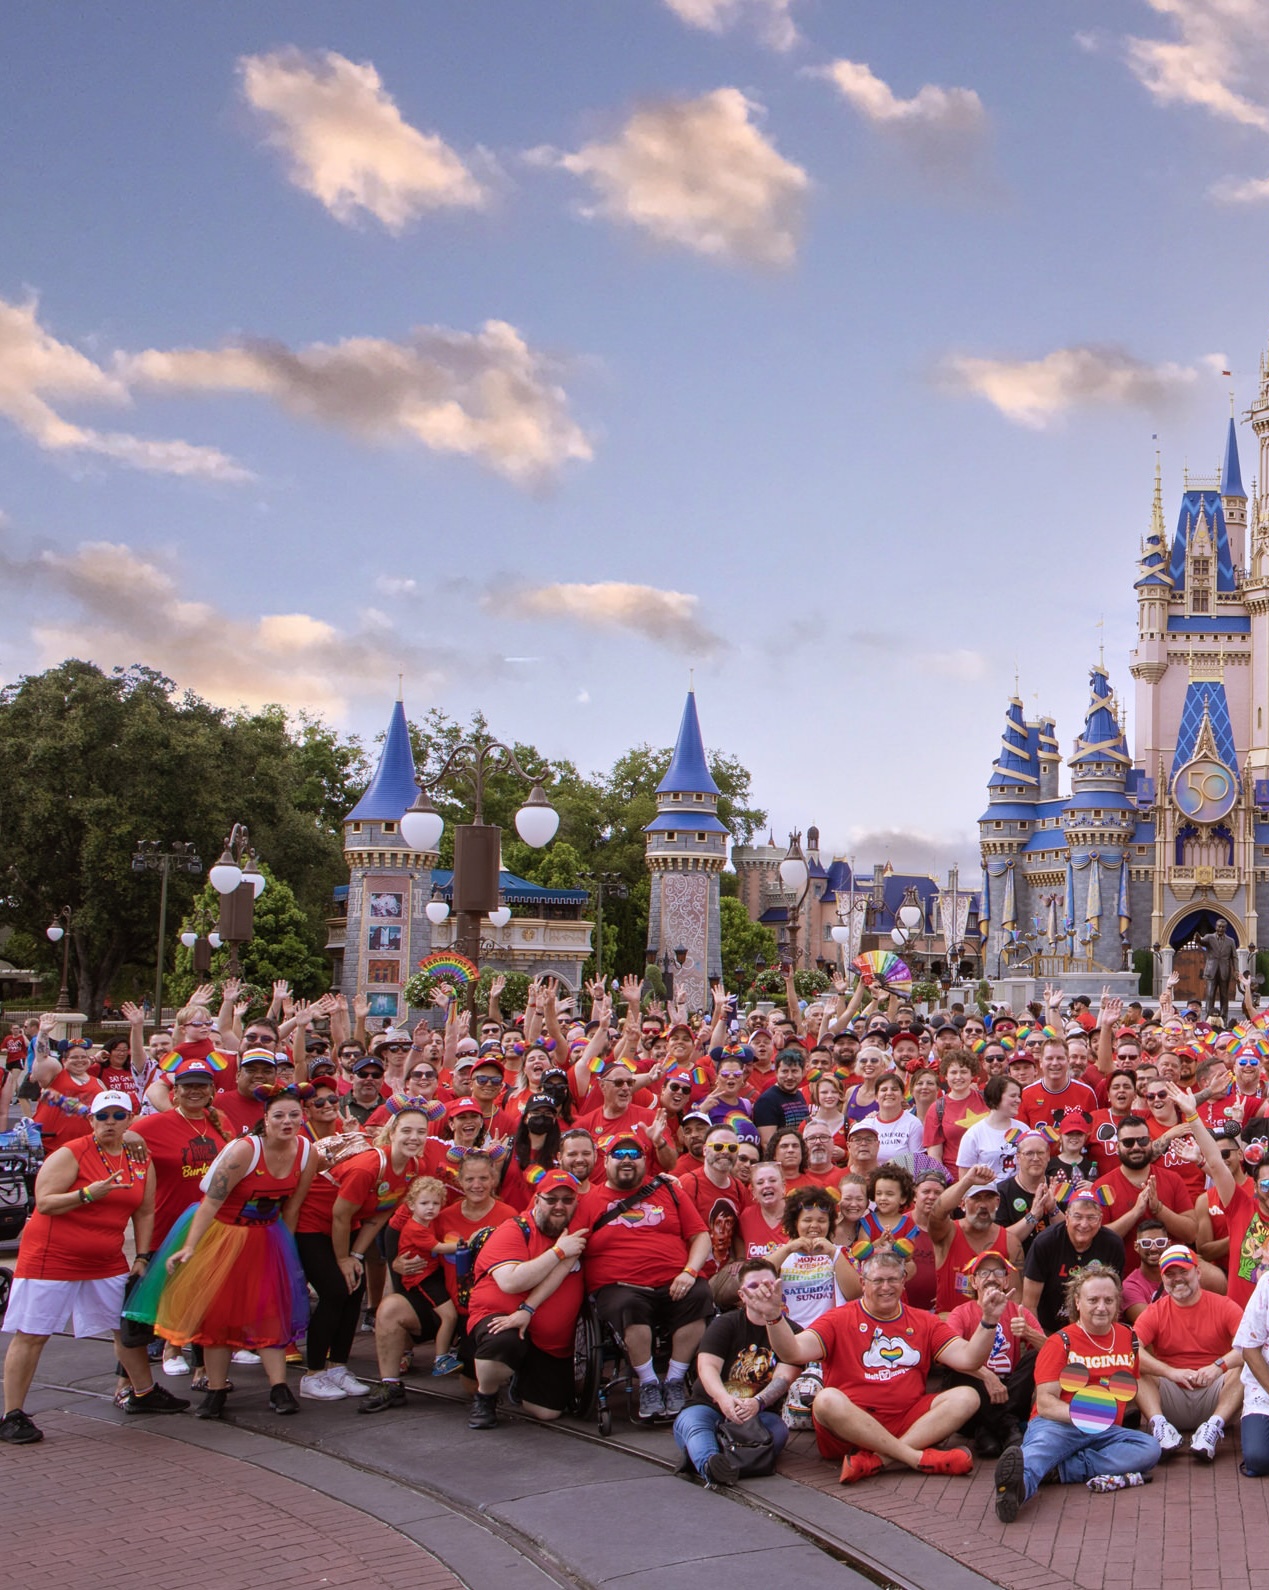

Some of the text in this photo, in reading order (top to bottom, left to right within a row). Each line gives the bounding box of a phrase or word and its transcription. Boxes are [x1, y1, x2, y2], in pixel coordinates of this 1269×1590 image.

[1188, 770, 1229, 815] 50
[533, 1095, 555, 1104] LOVE
[784, 1284, 834, 1295] SATURDAY
[796, 1292, 834, 1301] SUNDAY
